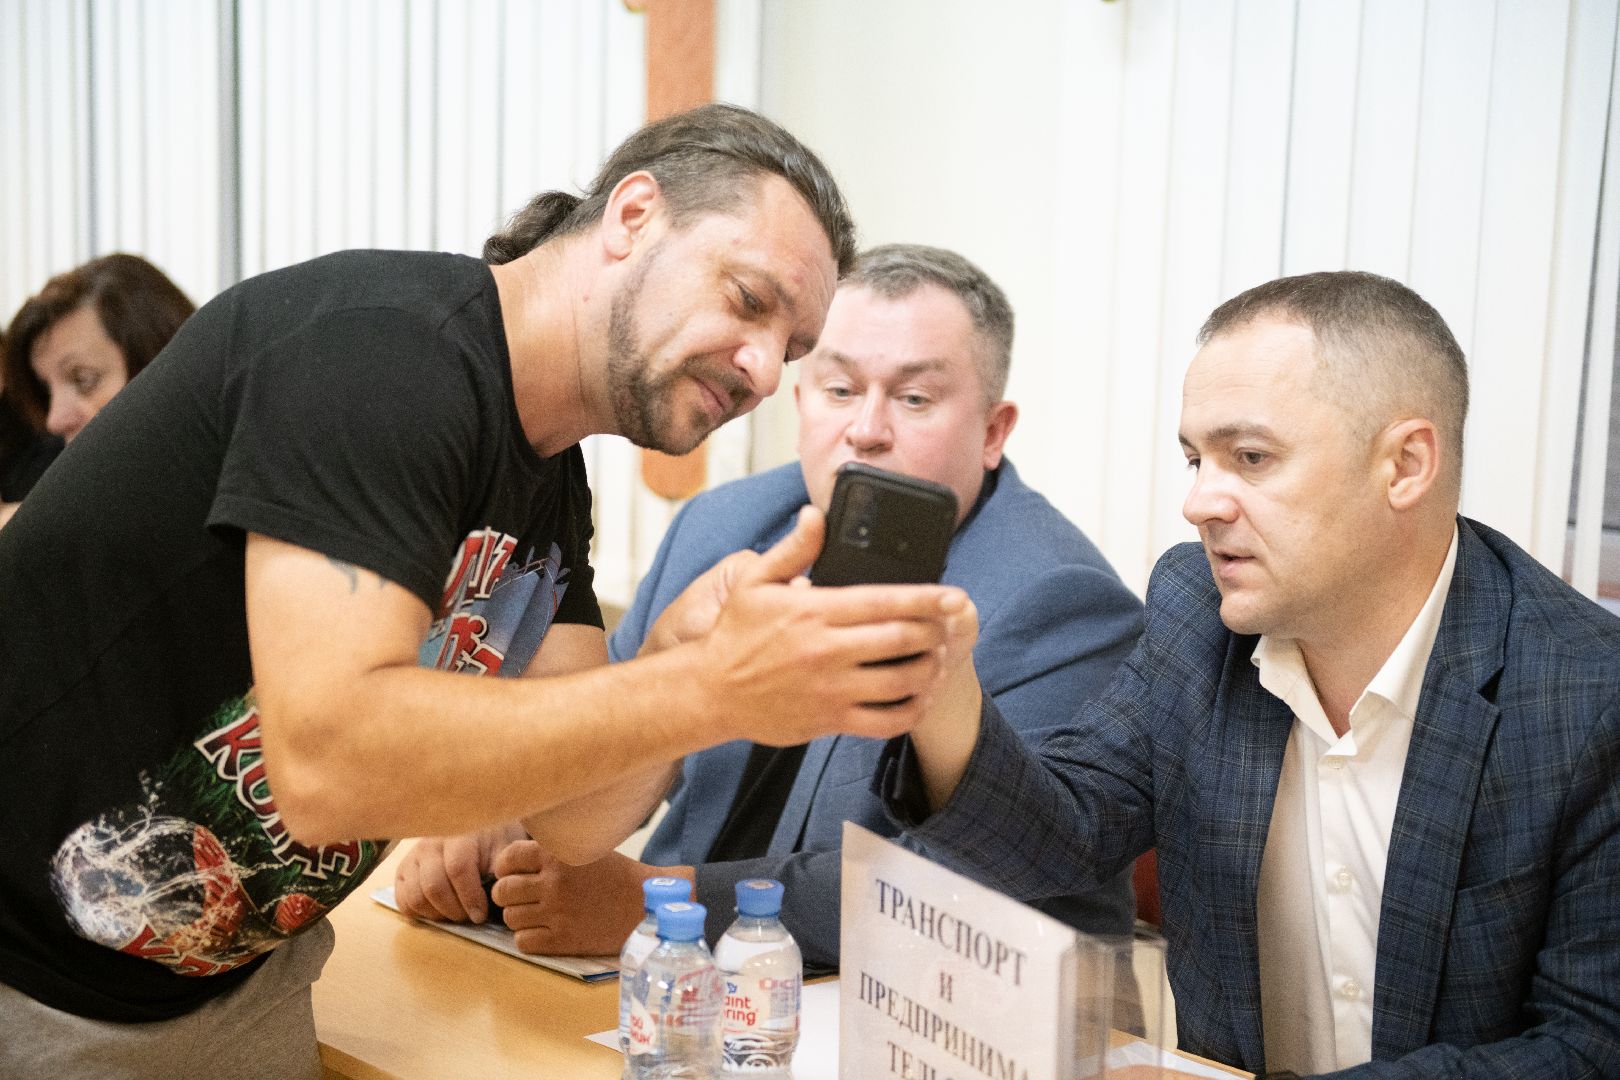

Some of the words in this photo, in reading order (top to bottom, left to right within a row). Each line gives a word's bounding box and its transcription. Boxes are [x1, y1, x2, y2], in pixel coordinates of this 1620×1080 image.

[875, 878, 1028, 986] ТРАНСПОРТ
[939, 970, 954, 1004] И
[725, 996, 752, 1009] aint
[724, 1009, 756, 1026] ring
